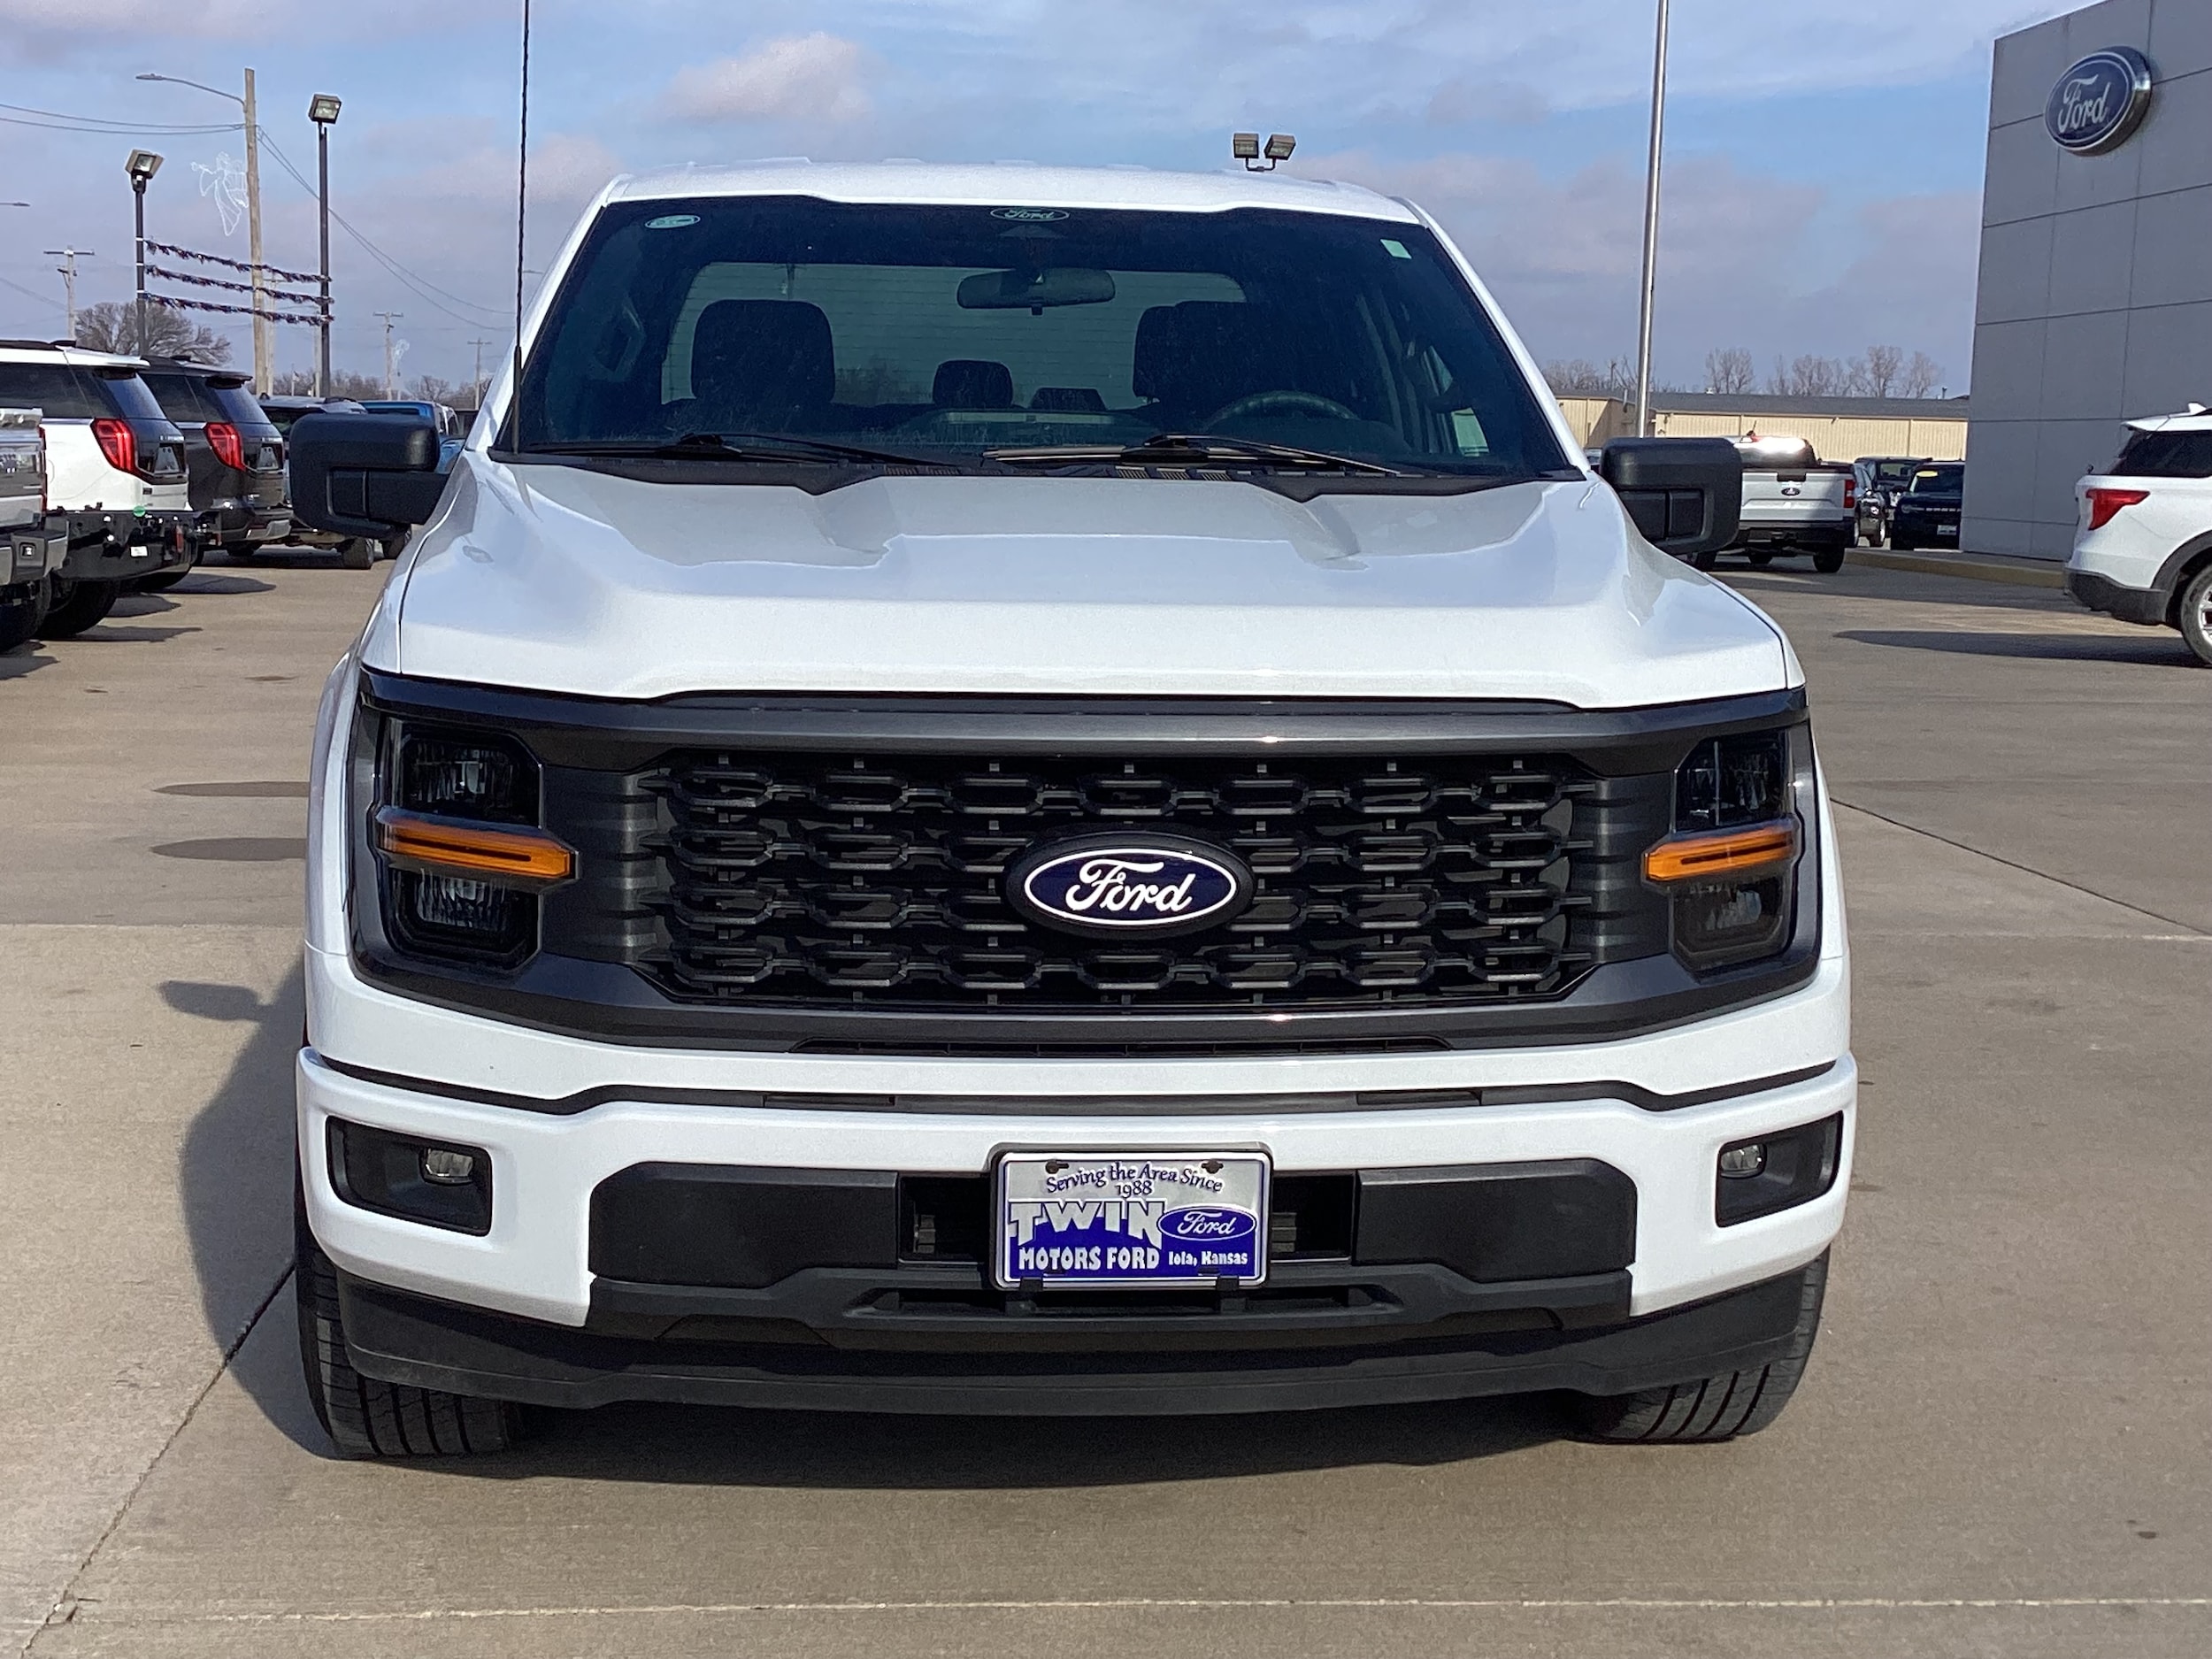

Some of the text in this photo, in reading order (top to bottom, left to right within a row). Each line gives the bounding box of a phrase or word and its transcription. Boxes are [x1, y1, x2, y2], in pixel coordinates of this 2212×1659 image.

[2057, 73, 2111, 134] Ford
[1004, 209, 1056, 220] Ford
[1065, 858, 1196, 912] Ford
[1047, 1161, 1224, 1194] Serving the Area Since
[1116, 1180, 1154, 1199] 1988
[1010, 1201, 1165, 1249] TWIN
[1177, 1210, 1237, 1235] Ford
[1018, 1246, 1161, 1271] MOTORS FORD
[1168, 1250, 1248, 1267] Iola, Kansas
